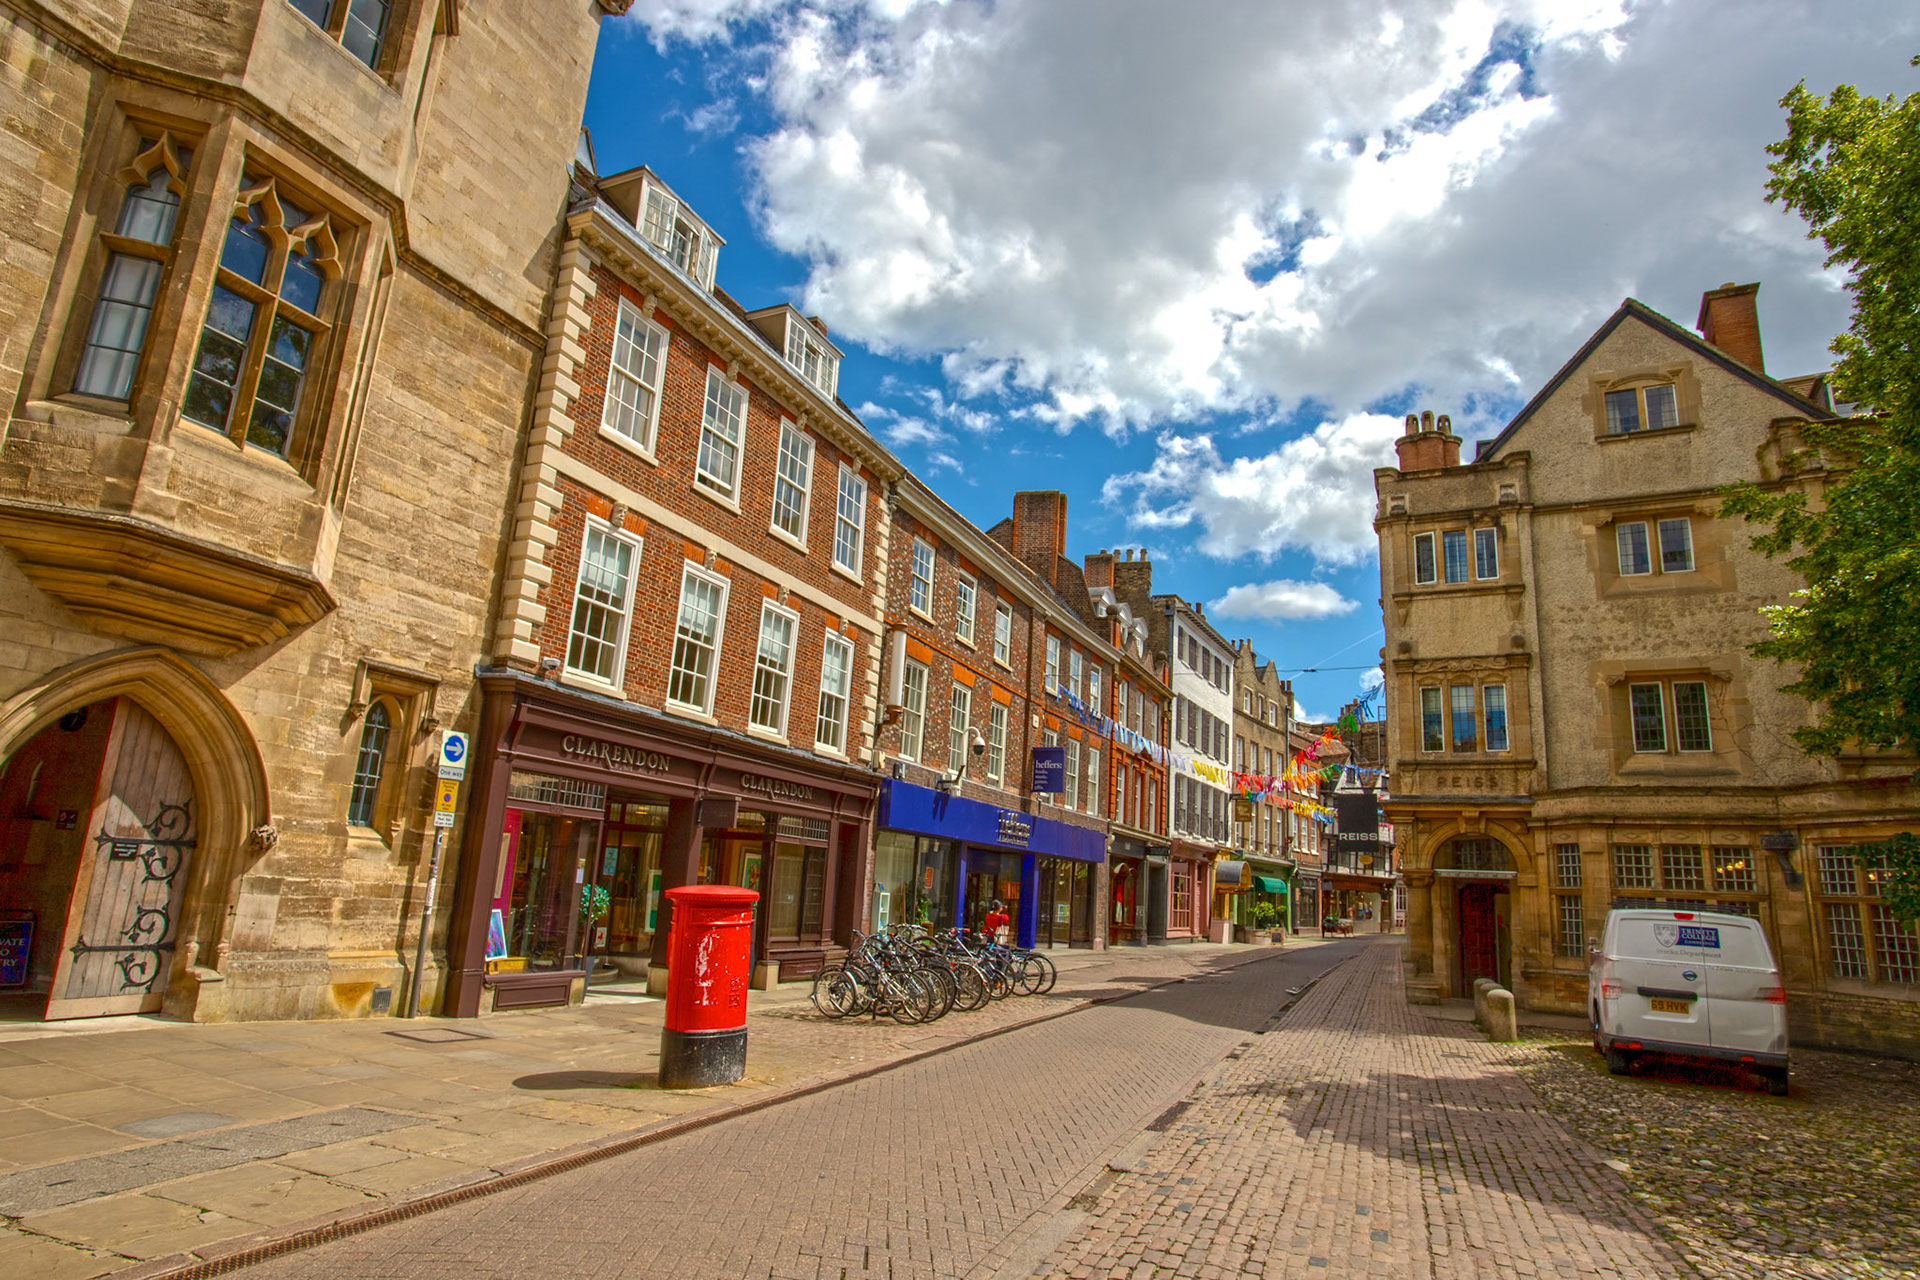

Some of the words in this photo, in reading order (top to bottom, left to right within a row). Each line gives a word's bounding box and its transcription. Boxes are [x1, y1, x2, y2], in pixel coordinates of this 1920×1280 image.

[563, 735, 671, 771] CLARENDON
[742, 774, 813, 800] CLARENDON
[1437, 776, 1498, 788] REISS
[1339, 832, 1378, 841] REISS
[1681, 928, 1716, 937] TRINITY
[1680, 949, 1722, 958] Department
[1666, 1001, 1687, 1012] HVK
